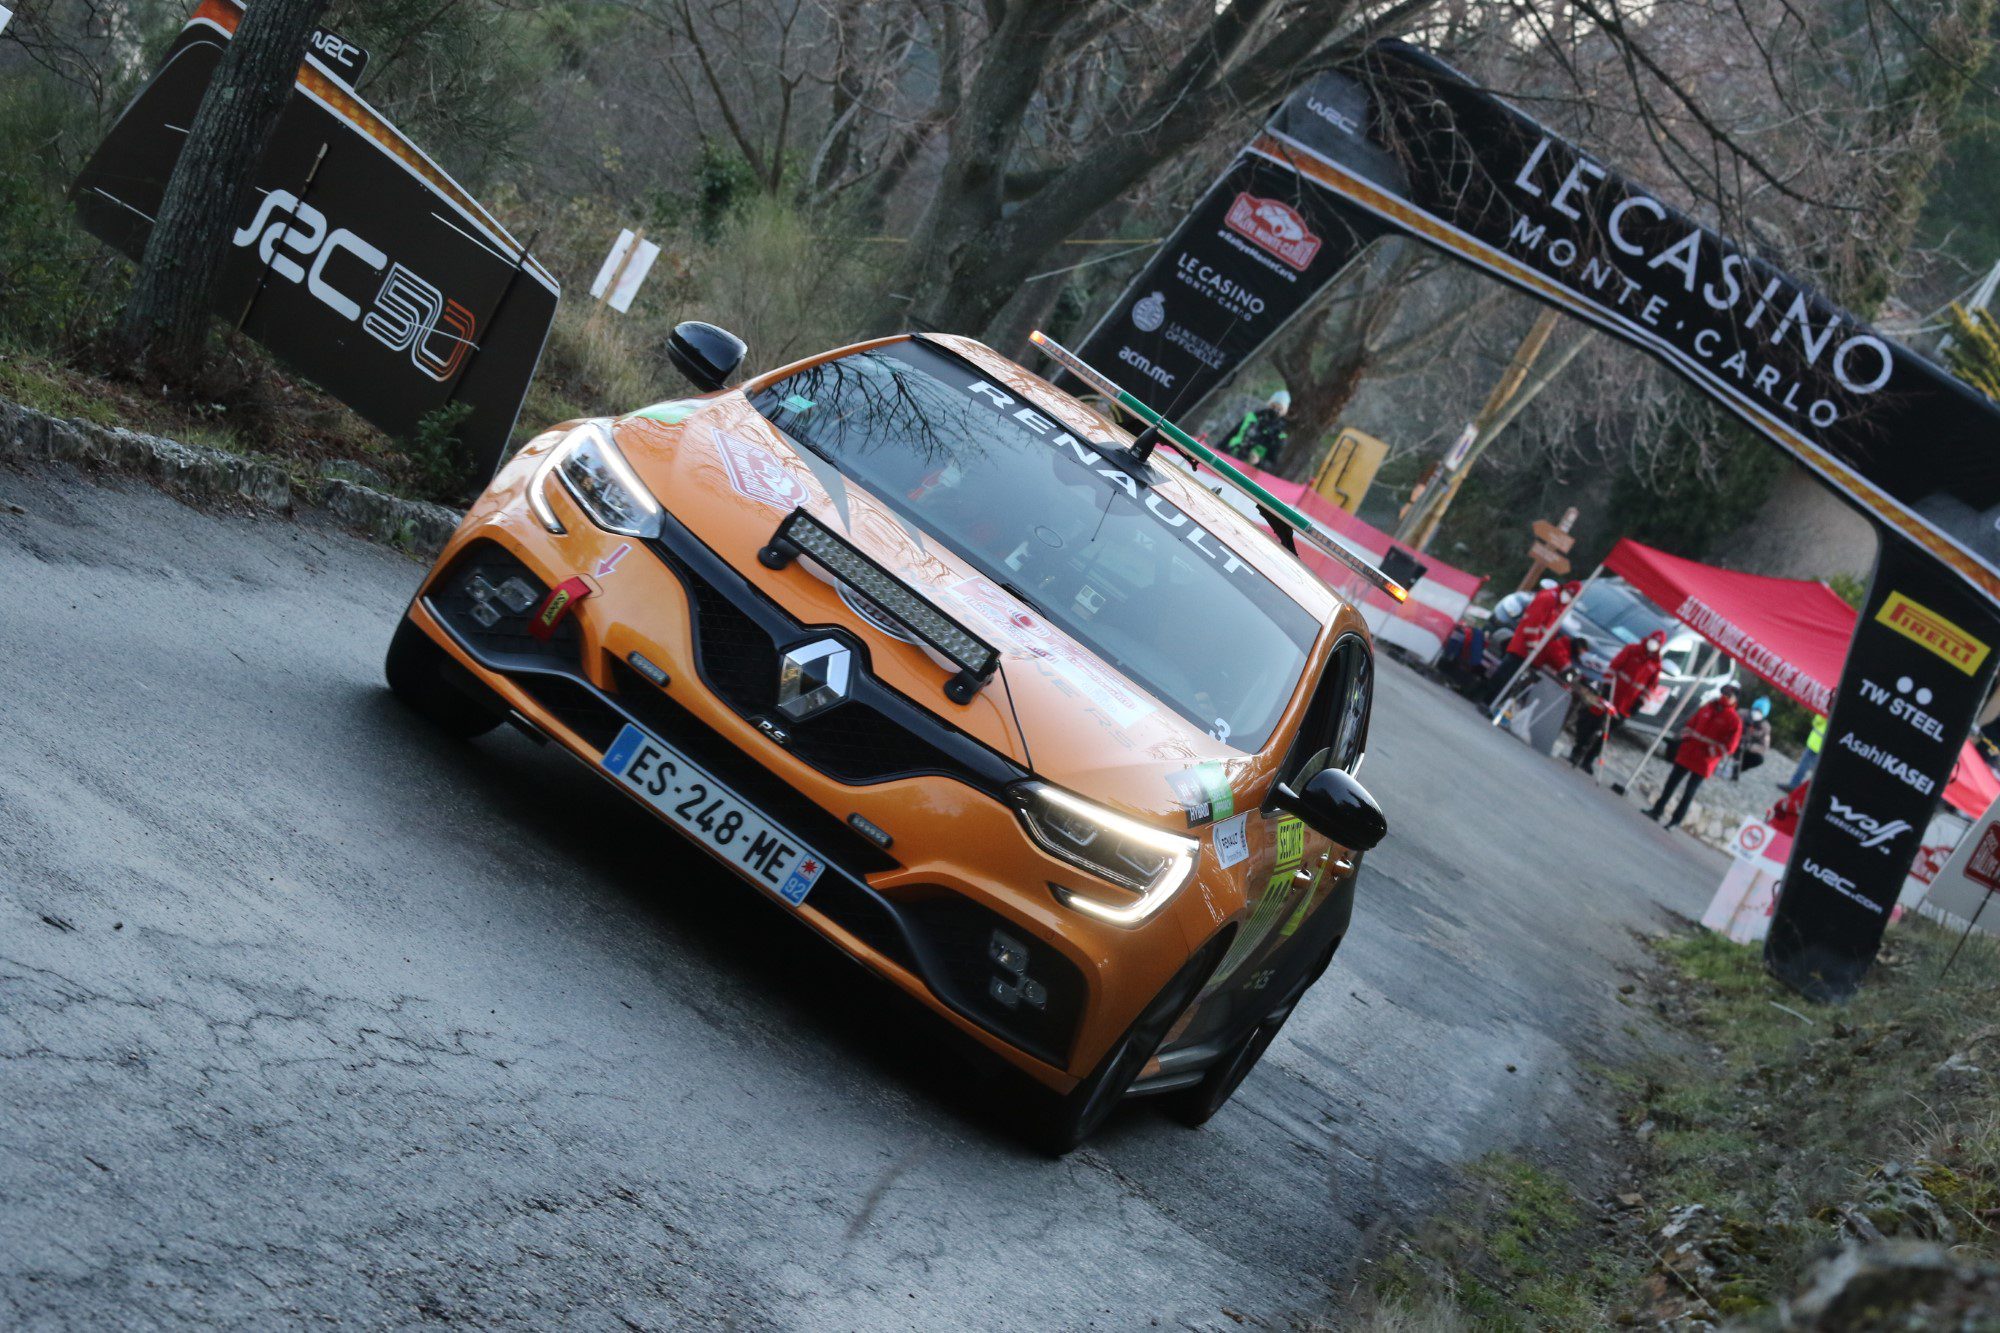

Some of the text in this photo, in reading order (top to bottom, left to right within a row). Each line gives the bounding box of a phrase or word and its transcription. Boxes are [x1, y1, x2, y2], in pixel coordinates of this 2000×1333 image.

[1177, 252, 1265, 314] LE CASINO
[1515, 137, 1894, 395] LE CASINO
[1118, 345, 1175, 389] acm.mc
[967, 380, 1255, 577] RENAULT
[1888, 602, 1978, 665] PIRELLI
[1860, 678, 1945, 743] TW STEEL
[786, 876, 806, 899] 92
